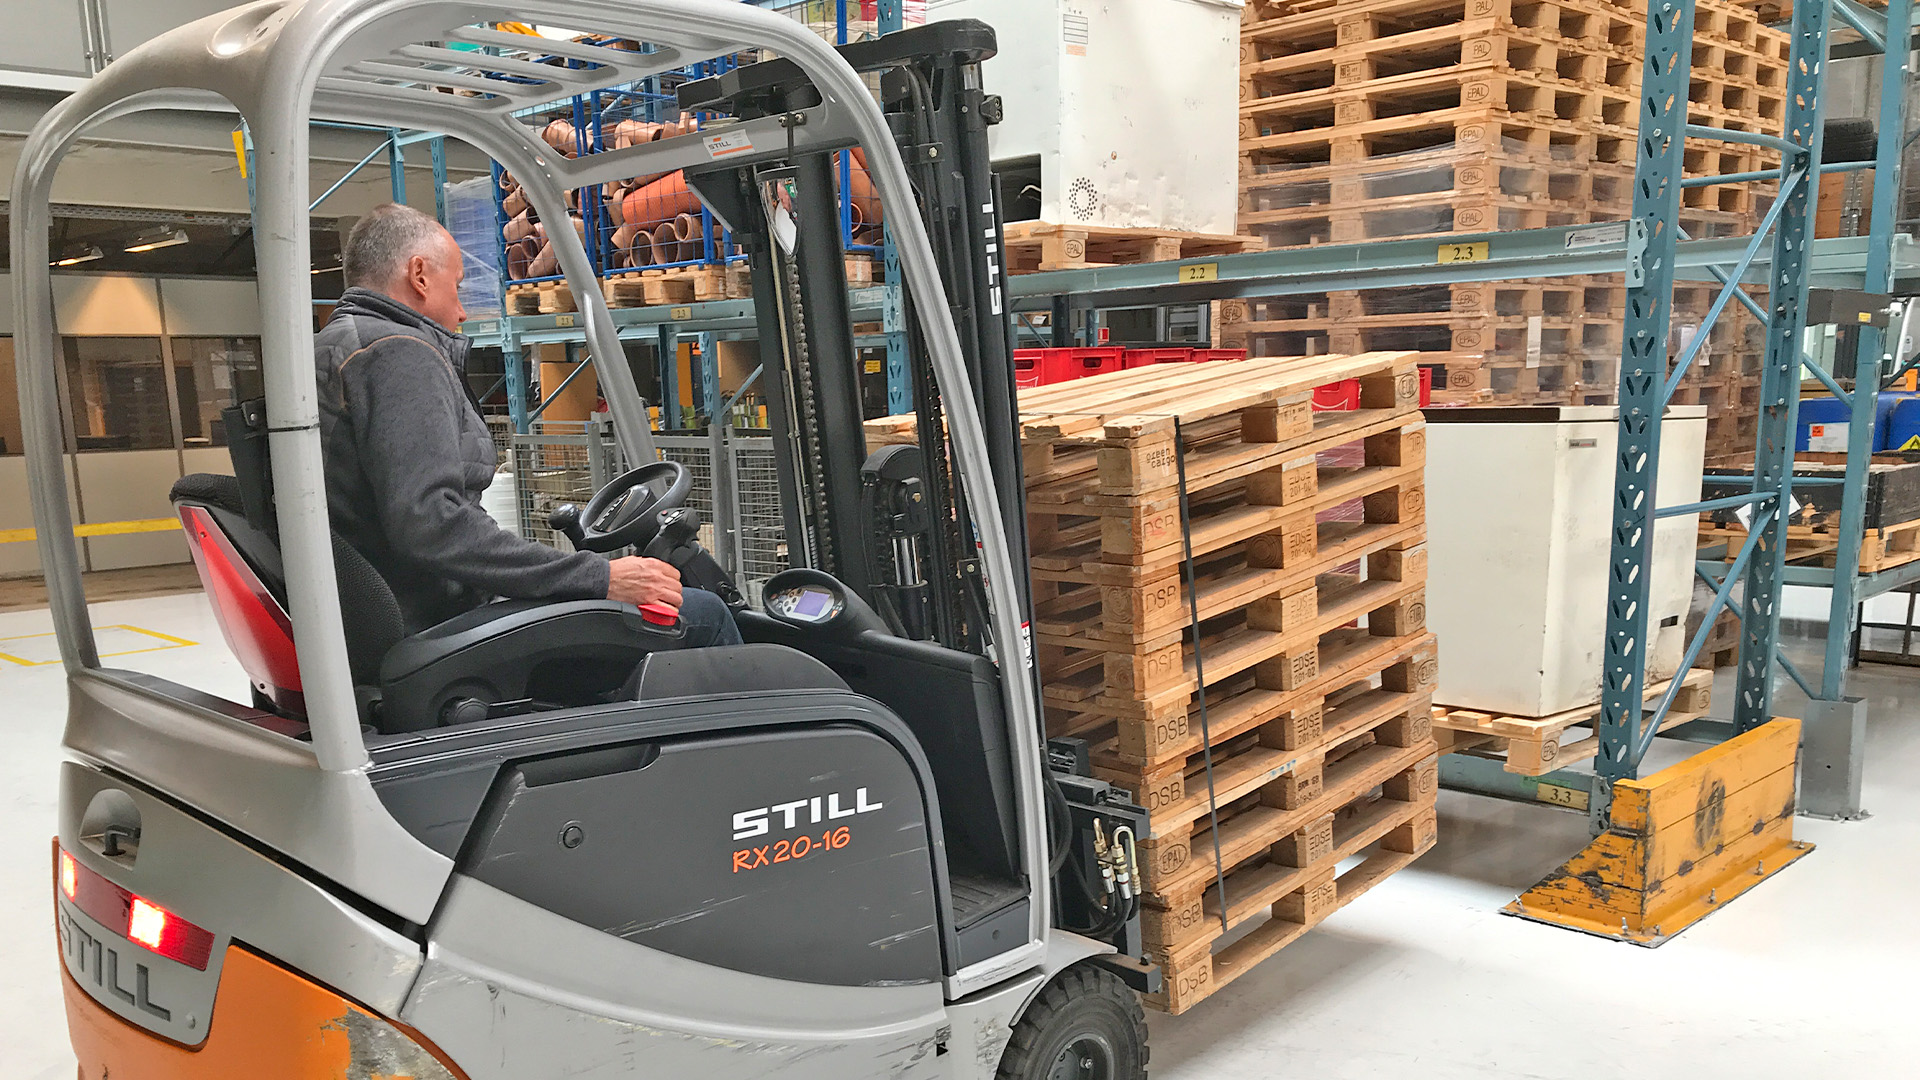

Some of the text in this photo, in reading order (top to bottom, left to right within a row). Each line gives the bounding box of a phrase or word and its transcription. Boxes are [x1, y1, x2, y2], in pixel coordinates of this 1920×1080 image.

[708, 141, 732, 150] STILL
[982, 188, 1003, 316] STILL
[1453, 246, 1474, 261] 2.3
[1189, 267, 1206, 280] 2.2
[1146, 447, 1171, 464] green
[1151, 454, 1176, 469] cargo
[1157, 714, 1188, 746] DSB
[1149, 781, 1181, 812] DSB
[1550, 787, 1572, 804] 3.3
[732, 787, 883, 841] STILL
[1161, 847, 1184, 872] EPAL
[1171, 902, 1201, 936] DSB
[59, 900, 171, 1023] STILL
[1178, 964, 1208, 998] DSB
